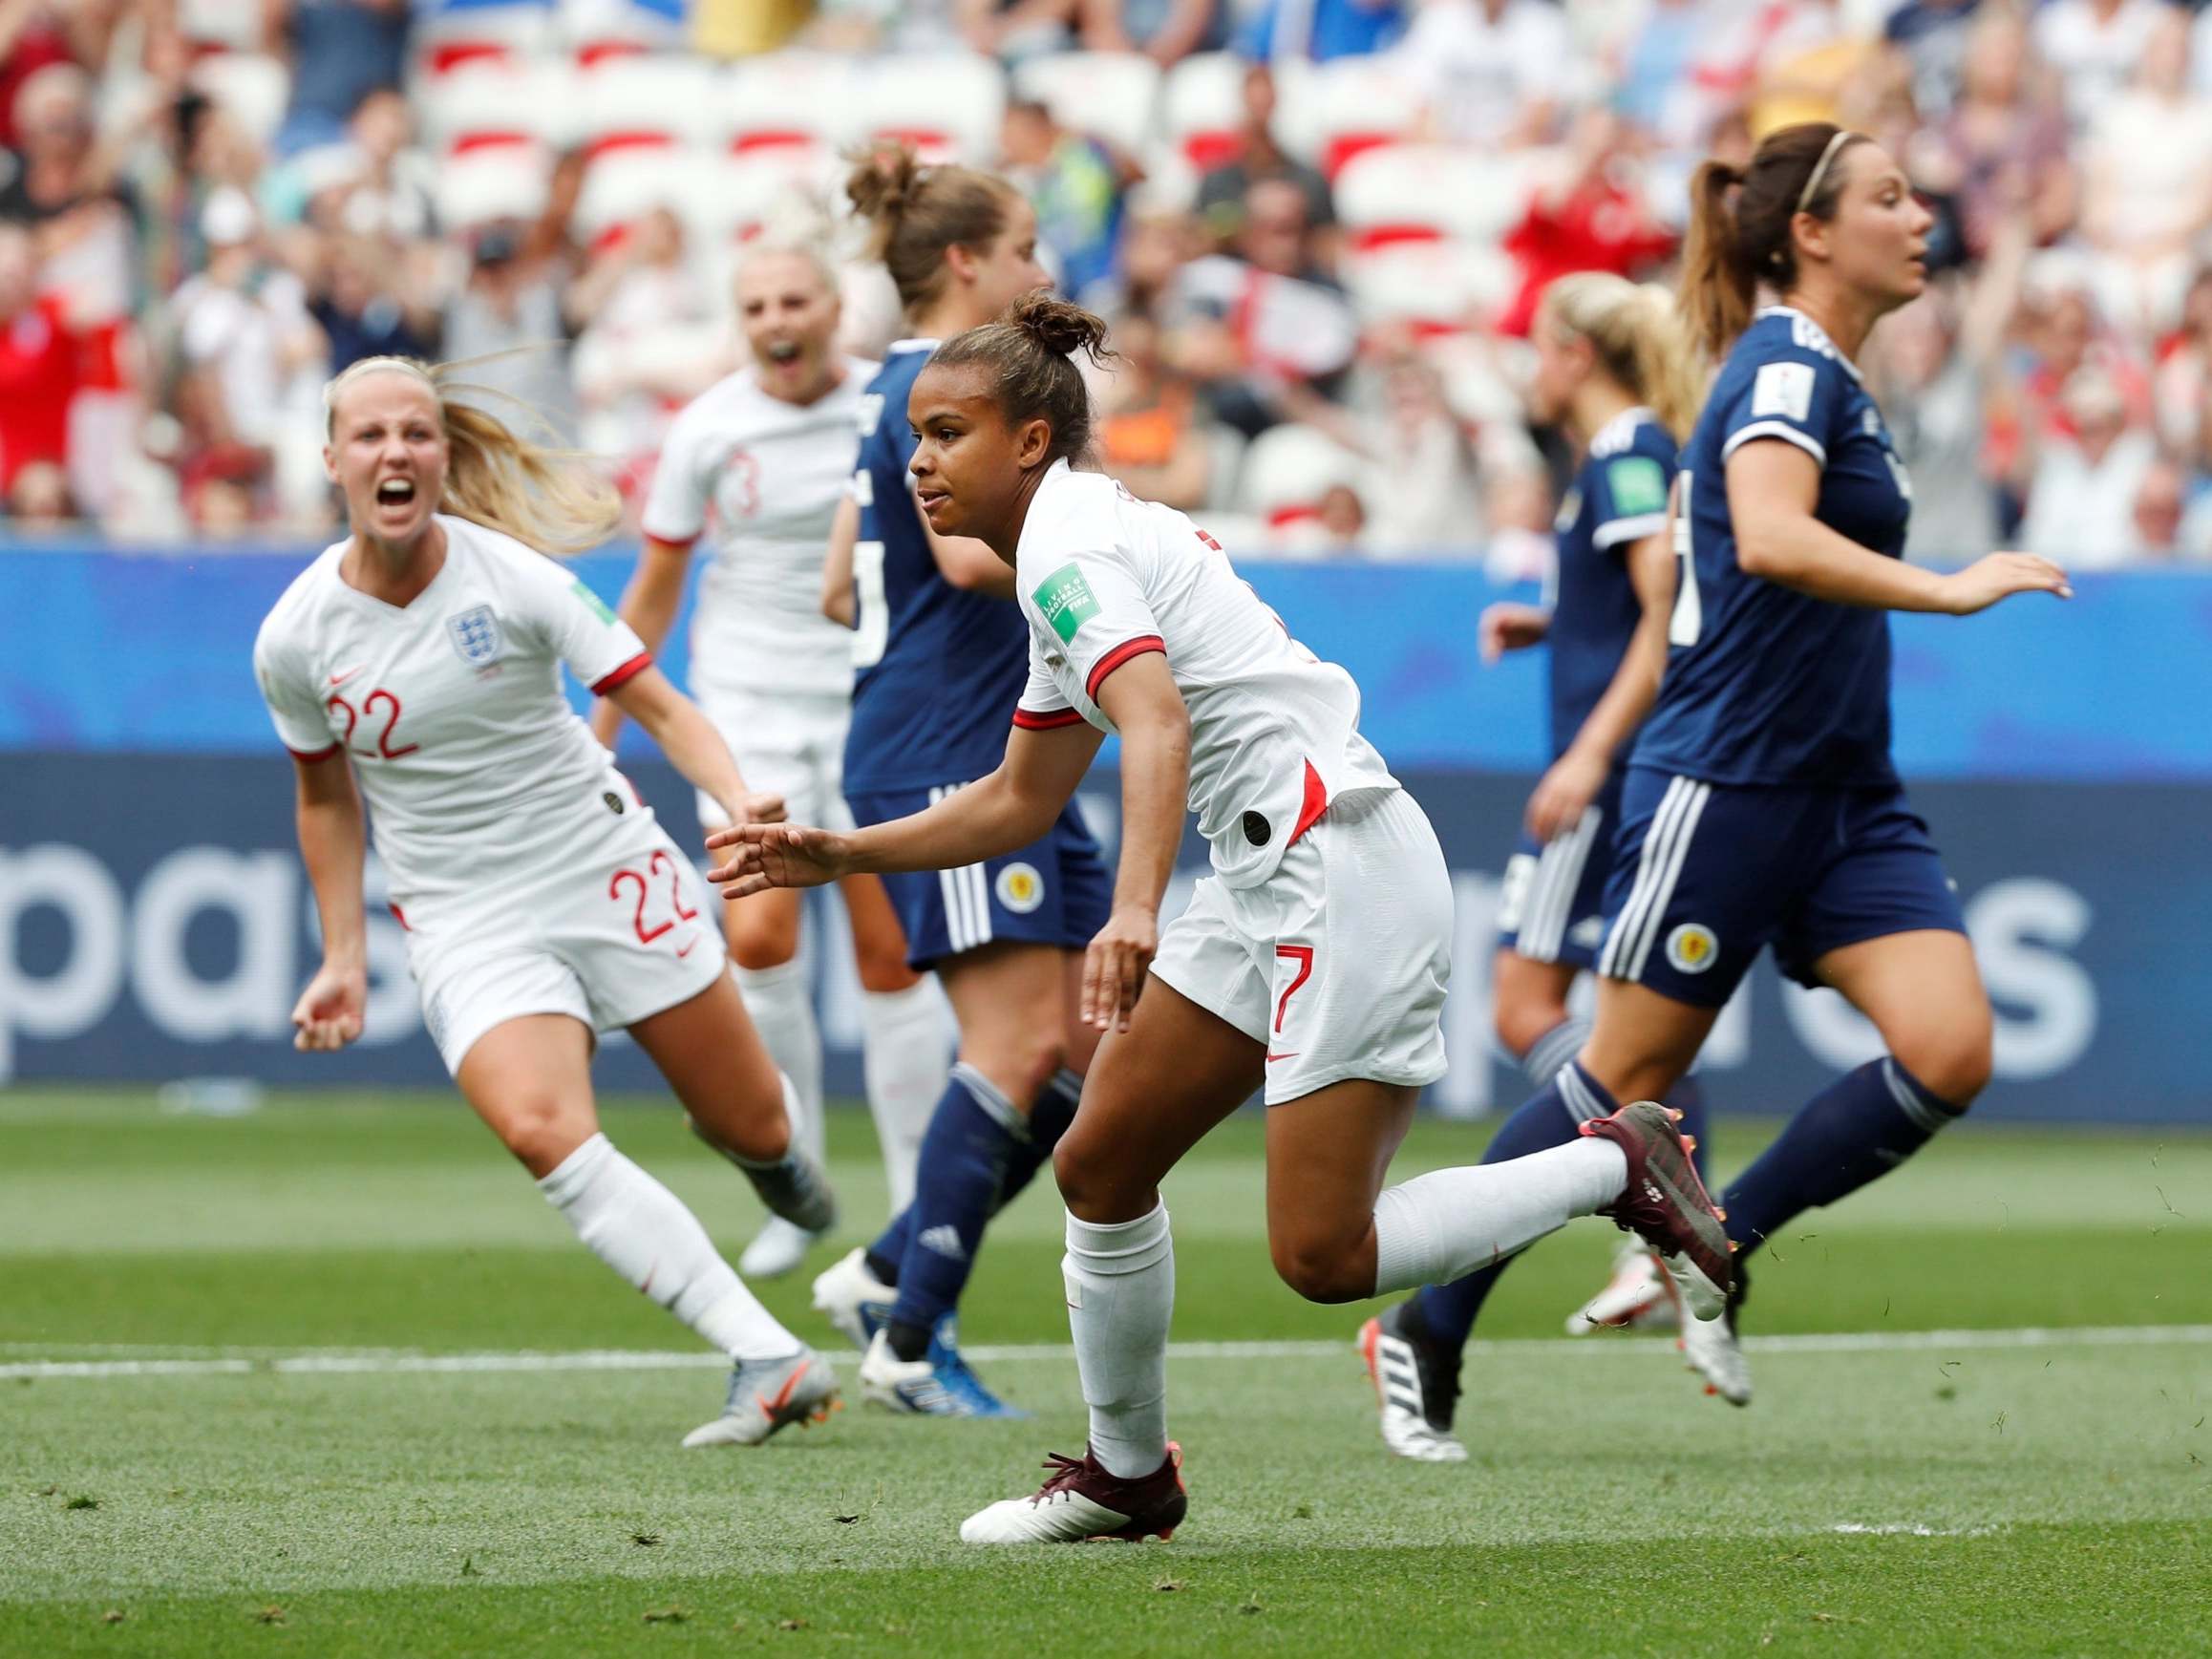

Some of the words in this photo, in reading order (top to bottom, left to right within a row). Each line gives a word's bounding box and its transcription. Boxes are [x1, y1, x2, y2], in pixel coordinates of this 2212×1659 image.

[1043, 577, 1081, 612] LIVING
[1068, 594, 1091, 612] FIFA
[328, 689, 420, 760] 22
[609, 849, 698, 944] 22
[1274, 944, 1314, 1033] 7
